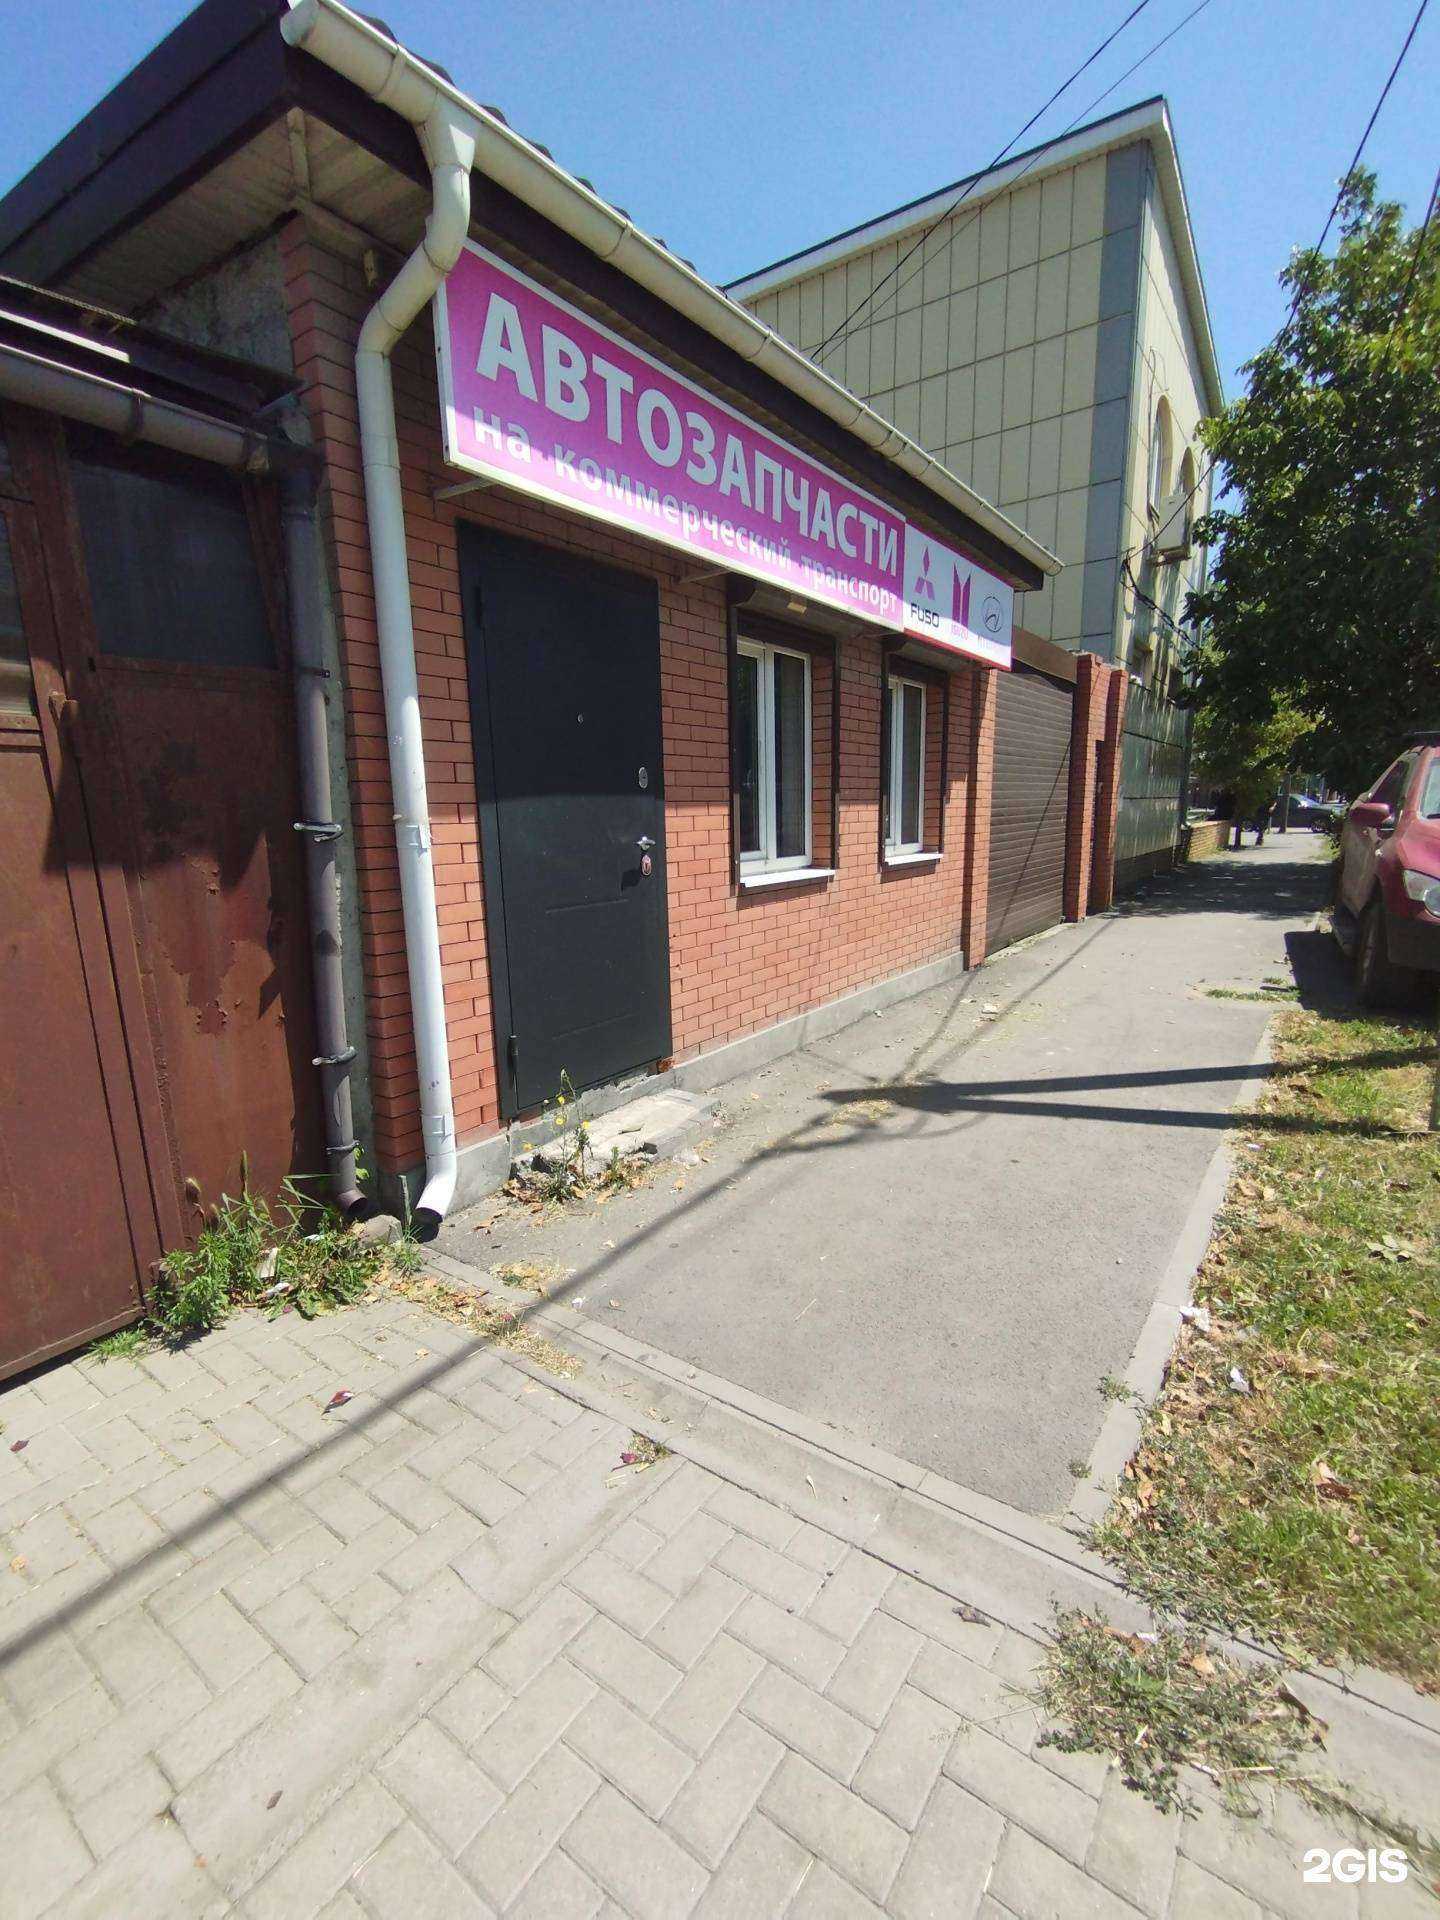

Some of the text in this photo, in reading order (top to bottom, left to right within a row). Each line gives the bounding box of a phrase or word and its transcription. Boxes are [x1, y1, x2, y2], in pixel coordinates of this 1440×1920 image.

[476, 407, 897, 613] на коммерческий транспорт
[477, 293, 897, 577] АВТОЗАПЧАСТИ
[910, 603, 940, 628] FUSO
